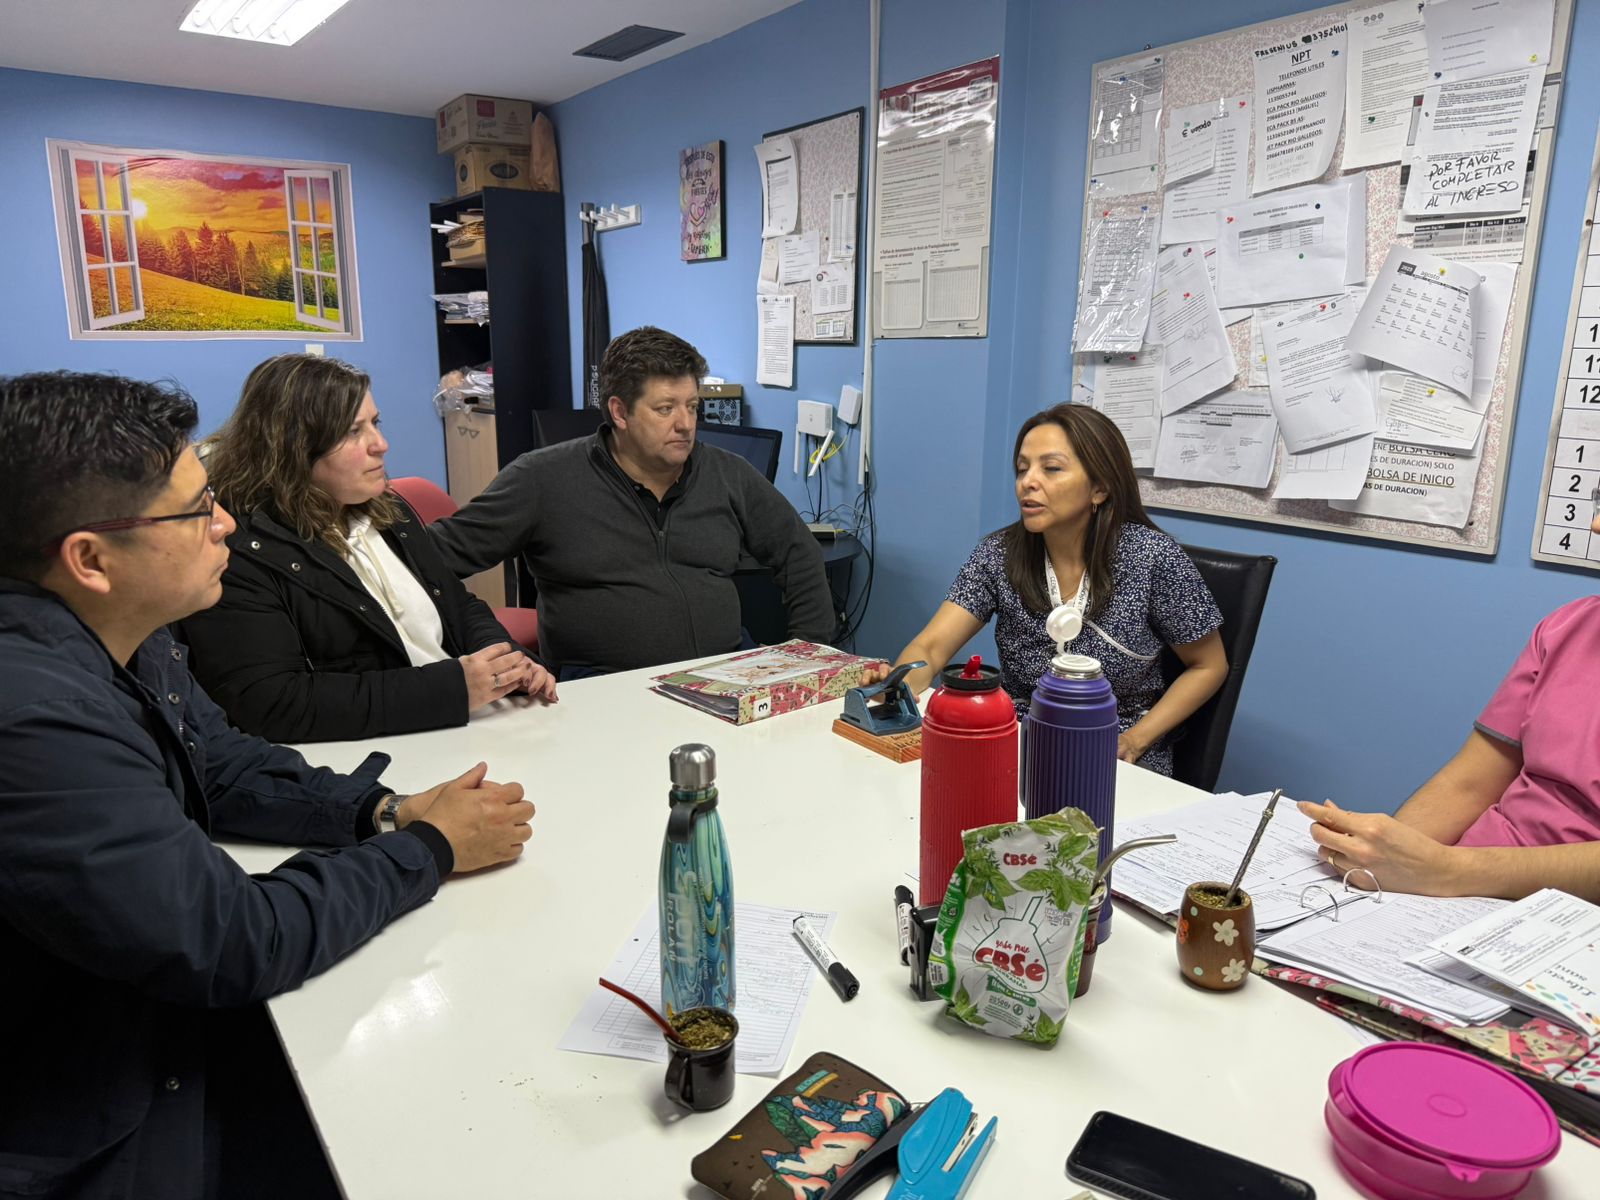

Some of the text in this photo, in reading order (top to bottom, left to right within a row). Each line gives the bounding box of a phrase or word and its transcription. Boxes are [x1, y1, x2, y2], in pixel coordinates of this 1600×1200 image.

[1291, 49, 1312, 64] NPT
[1278, 61, 1325, 81] TELEFONOS UTILES
[1276, 102, 1290, 110] PACK
[1290, 99, 1300, 107] RIO
[1276, 120, 1290, 129] PACK
[1275, 139, 1288, 148] PACK
[1287, 137, 1297, 145] RIO
[1429, 151, 1501, 181] POR FAVOR
[1432, 160, 1515, 191] COMPLETAR
[1425, 196, 1440, 209] AL
[1579, 384, 1600, 404] 12
[1575, 445, 1585, 463] 1
[1379, 456, 1389, 464] DE
[1391, 458, 1433, 469] DURACION)
[1434, 461, 1455, 471] SOLO
[1367, 468, 1455, 486] BOLSA DE INICIO
[1568, 474, 1582, 493] 2
[1374, 483, 1384, 491] DE
[1384, 484, 1428, 496] DURACION)
[1564, 503, 1576, 522] 3
[1559, 532, 1571, 551] 4
[757, 702, 768, 713] 3
[975, 946, 1046, 982] CBSé
